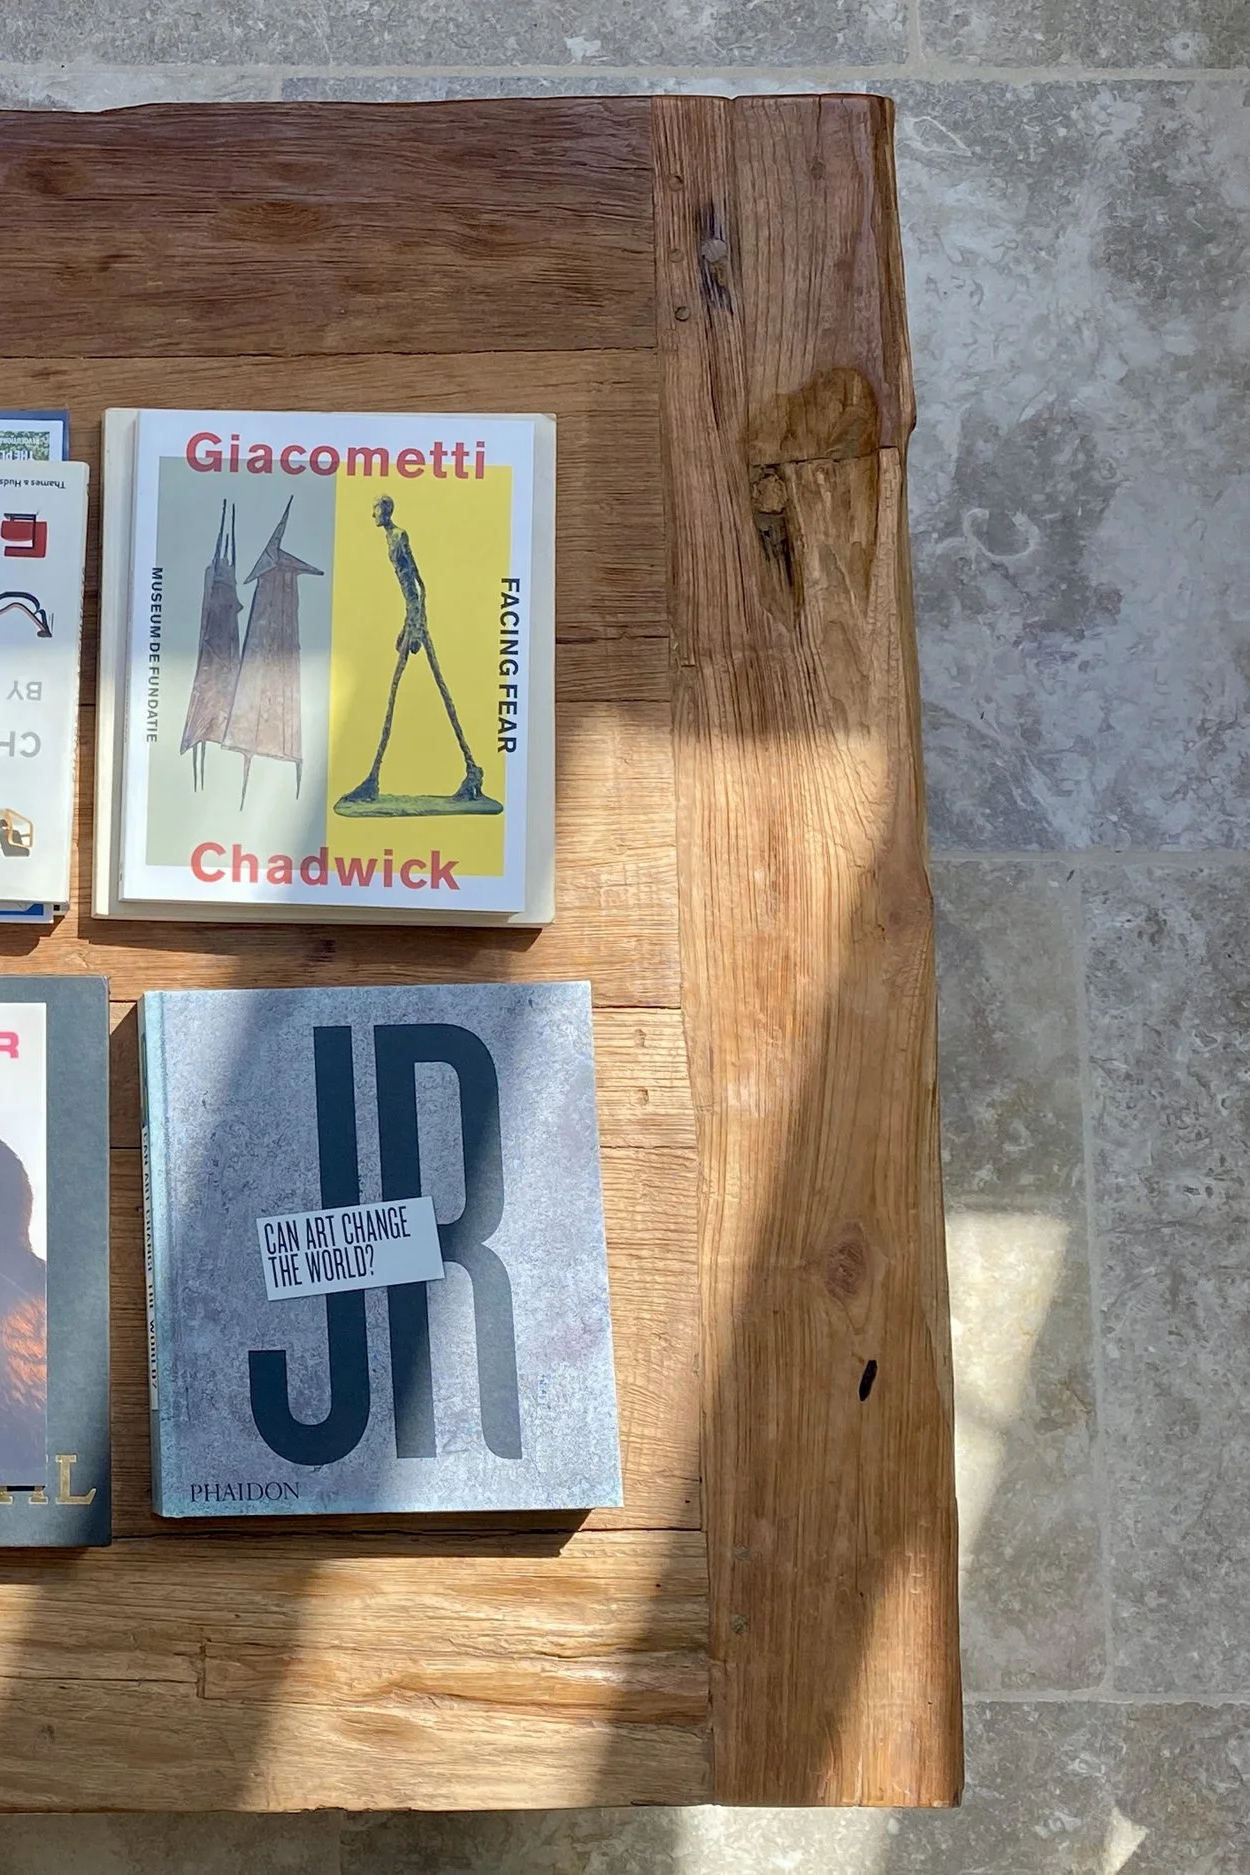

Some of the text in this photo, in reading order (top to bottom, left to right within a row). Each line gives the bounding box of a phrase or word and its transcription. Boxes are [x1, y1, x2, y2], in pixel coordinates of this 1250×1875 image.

[185, 432, 486, 479] Giacometti
[30, 479, 67, 489] Thames
[146, 567, 163, 743] MUSEUM DE FUNDATIE
[497, 577, 521, 754] FACING FEAR
[6, 680, 42, 701] BY
[190, 842, 460, 890] Chadwick
[248, 1022, 523, 1466] JR
[264, 1206, 411, 1255] CAN ART CHANGE
[268, 1242, 375, 1288] THE WORLD?
[190, 1481, 300, 1503] PHAIDON
